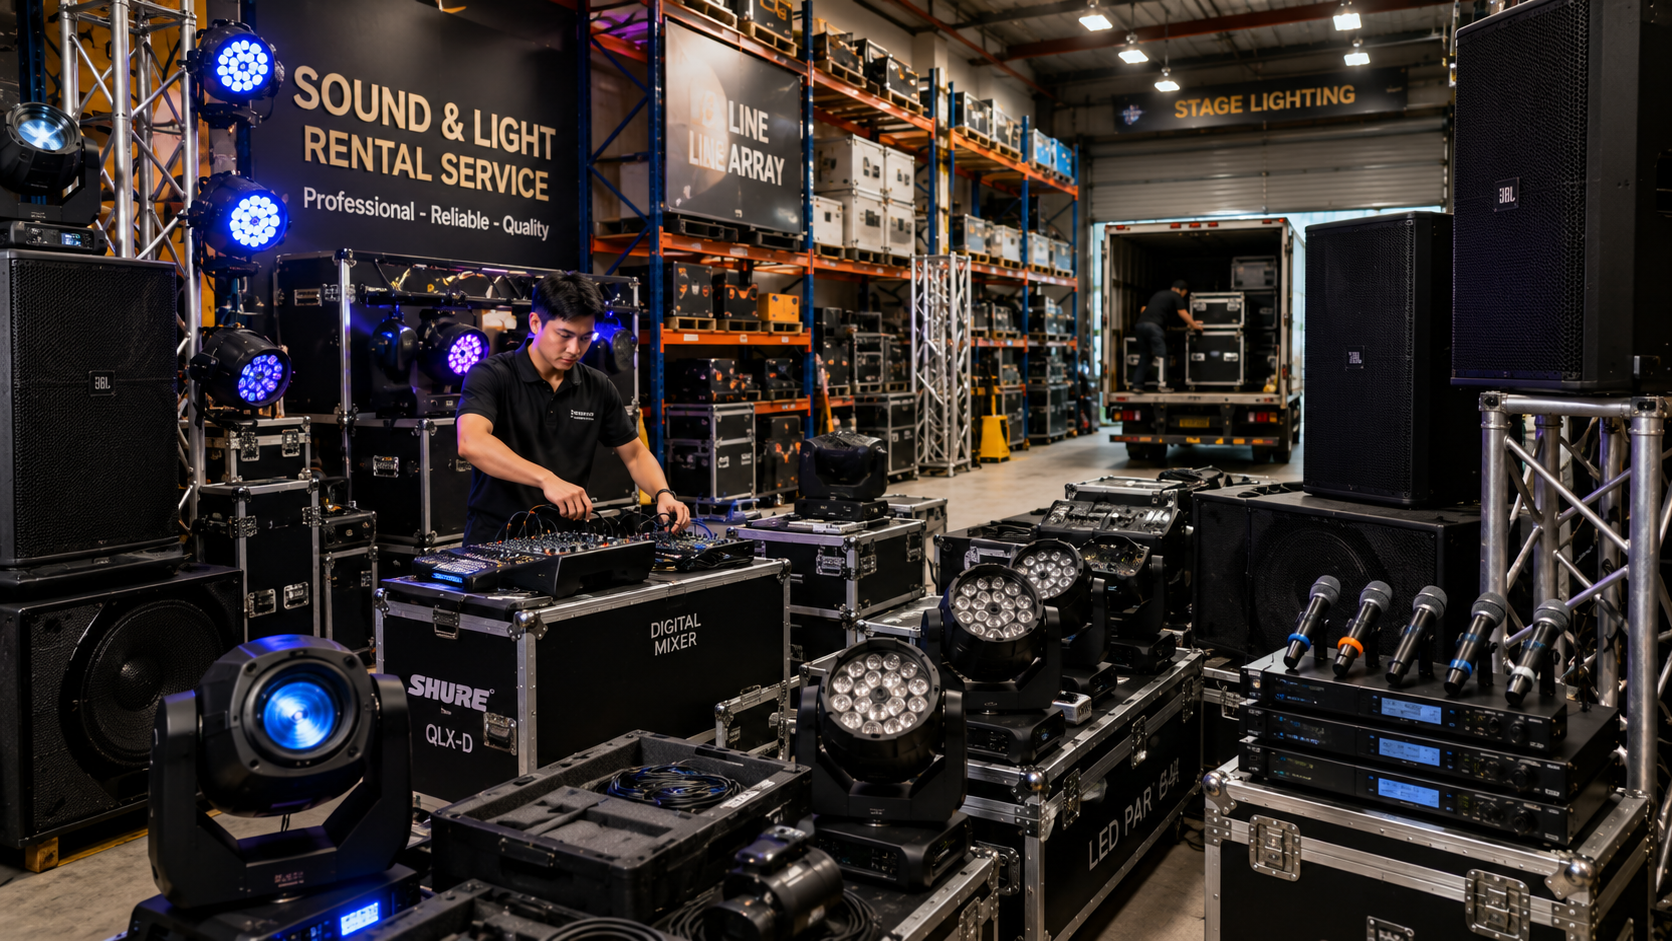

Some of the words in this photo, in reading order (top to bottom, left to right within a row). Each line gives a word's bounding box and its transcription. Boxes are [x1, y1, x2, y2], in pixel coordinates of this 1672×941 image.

[293, 65, 431, 133] SOUND
[441, 102, 465, 142] &
[474, 108, 556, 161] LIGHT
[728, 100, 769, 144] LINE
[1174, 95, 1243, 119] STAGE
[1250, 84, 1356, 113] LIGHTING
[304, 124, 432, 182] RENTAL
[440, 152, 549, 202] SERVICE
[689, 130, 726, 172] LINE
[728, 143, 785, 186] ARRAY
[303, 186, 415, 221] Professional
[431, 205, 489, 231] Reliable
[502, 215, 550, 241] Quality
[651, 612, 702, 639] DIGITAL
[654, 631, 698, 656] MIXER
[407, 674, 490, 712] SHURE
[425, 723, 473, 754] QLX-D
[1088, 818, 1119, 872] LED
[1124, 786, 1152, 837] PAR
